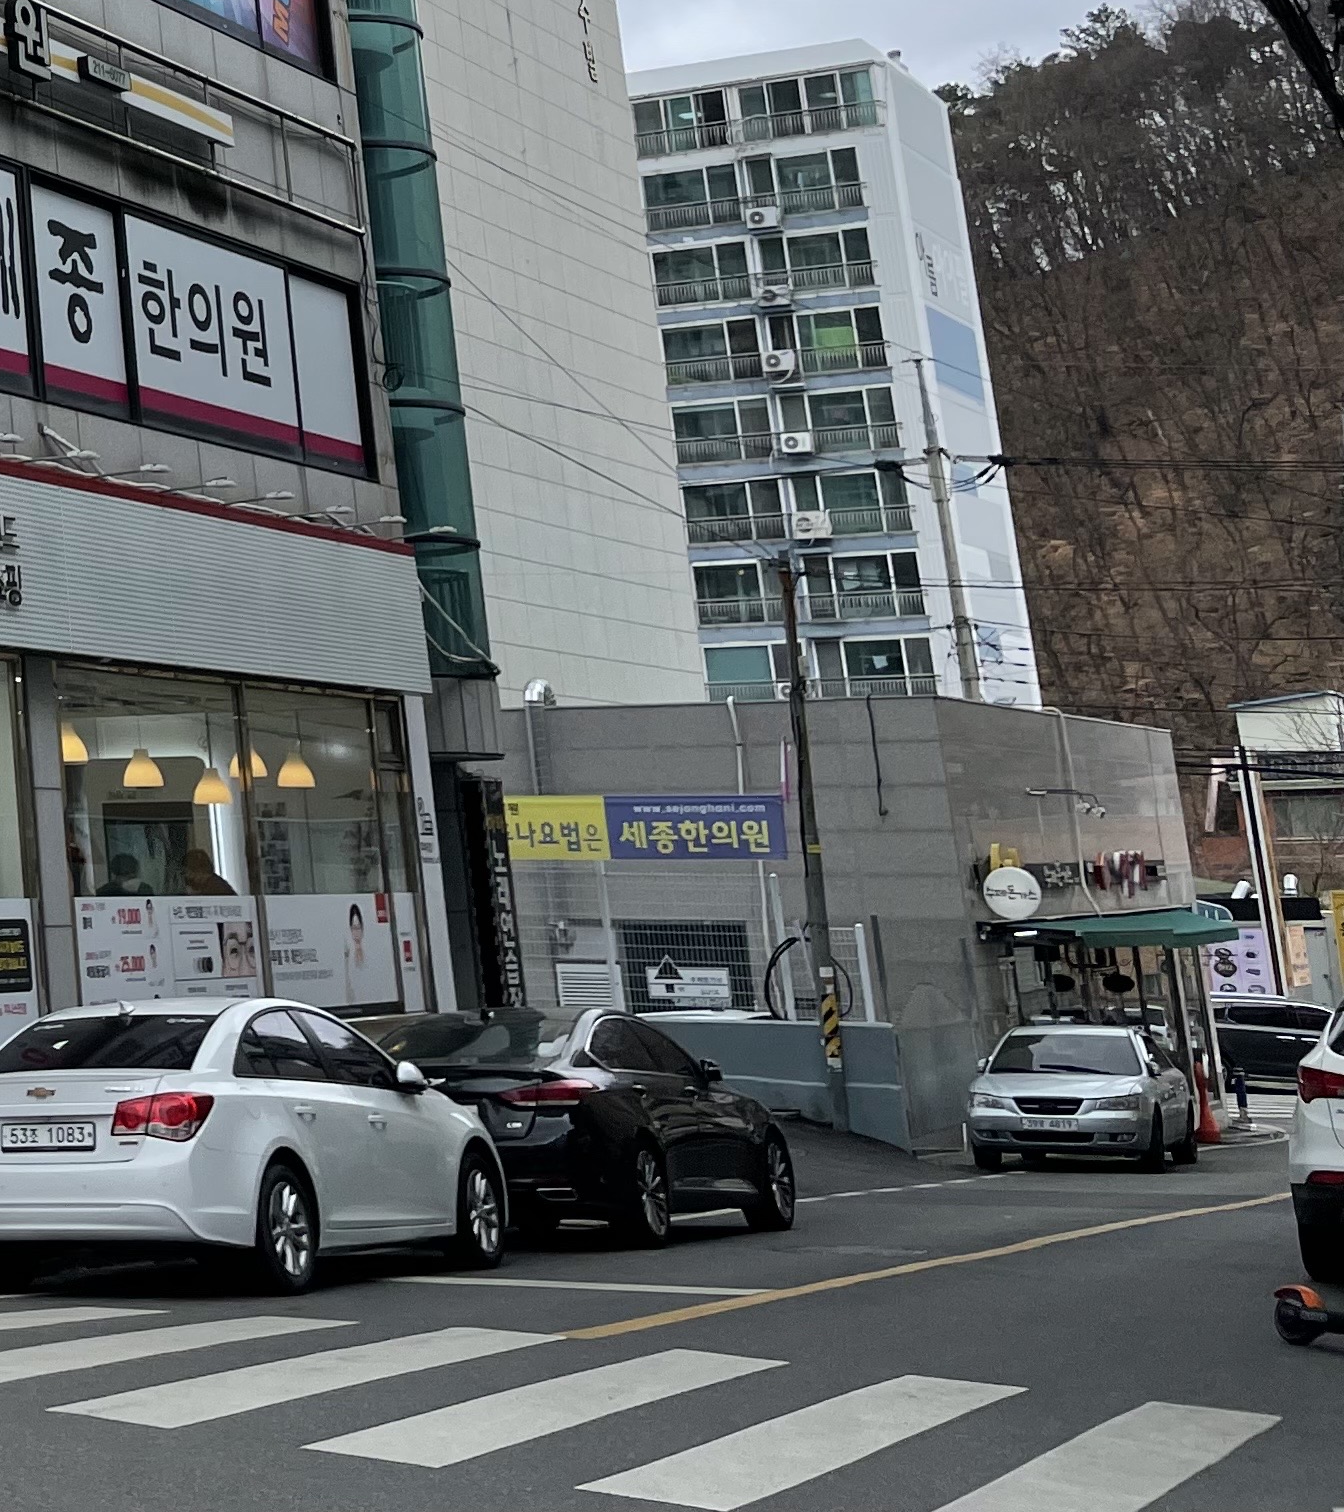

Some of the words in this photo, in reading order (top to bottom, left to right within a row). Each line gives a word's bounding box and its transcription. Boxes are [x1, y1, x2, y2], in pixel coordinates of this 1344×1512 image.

[633, 803, 766, 814] www.sejonghani.com
[507, 821, 603, 853] 나요법은
[620, 820, 770, 854] 세종한의원
[46, 1126, 85, 1144] 1083
